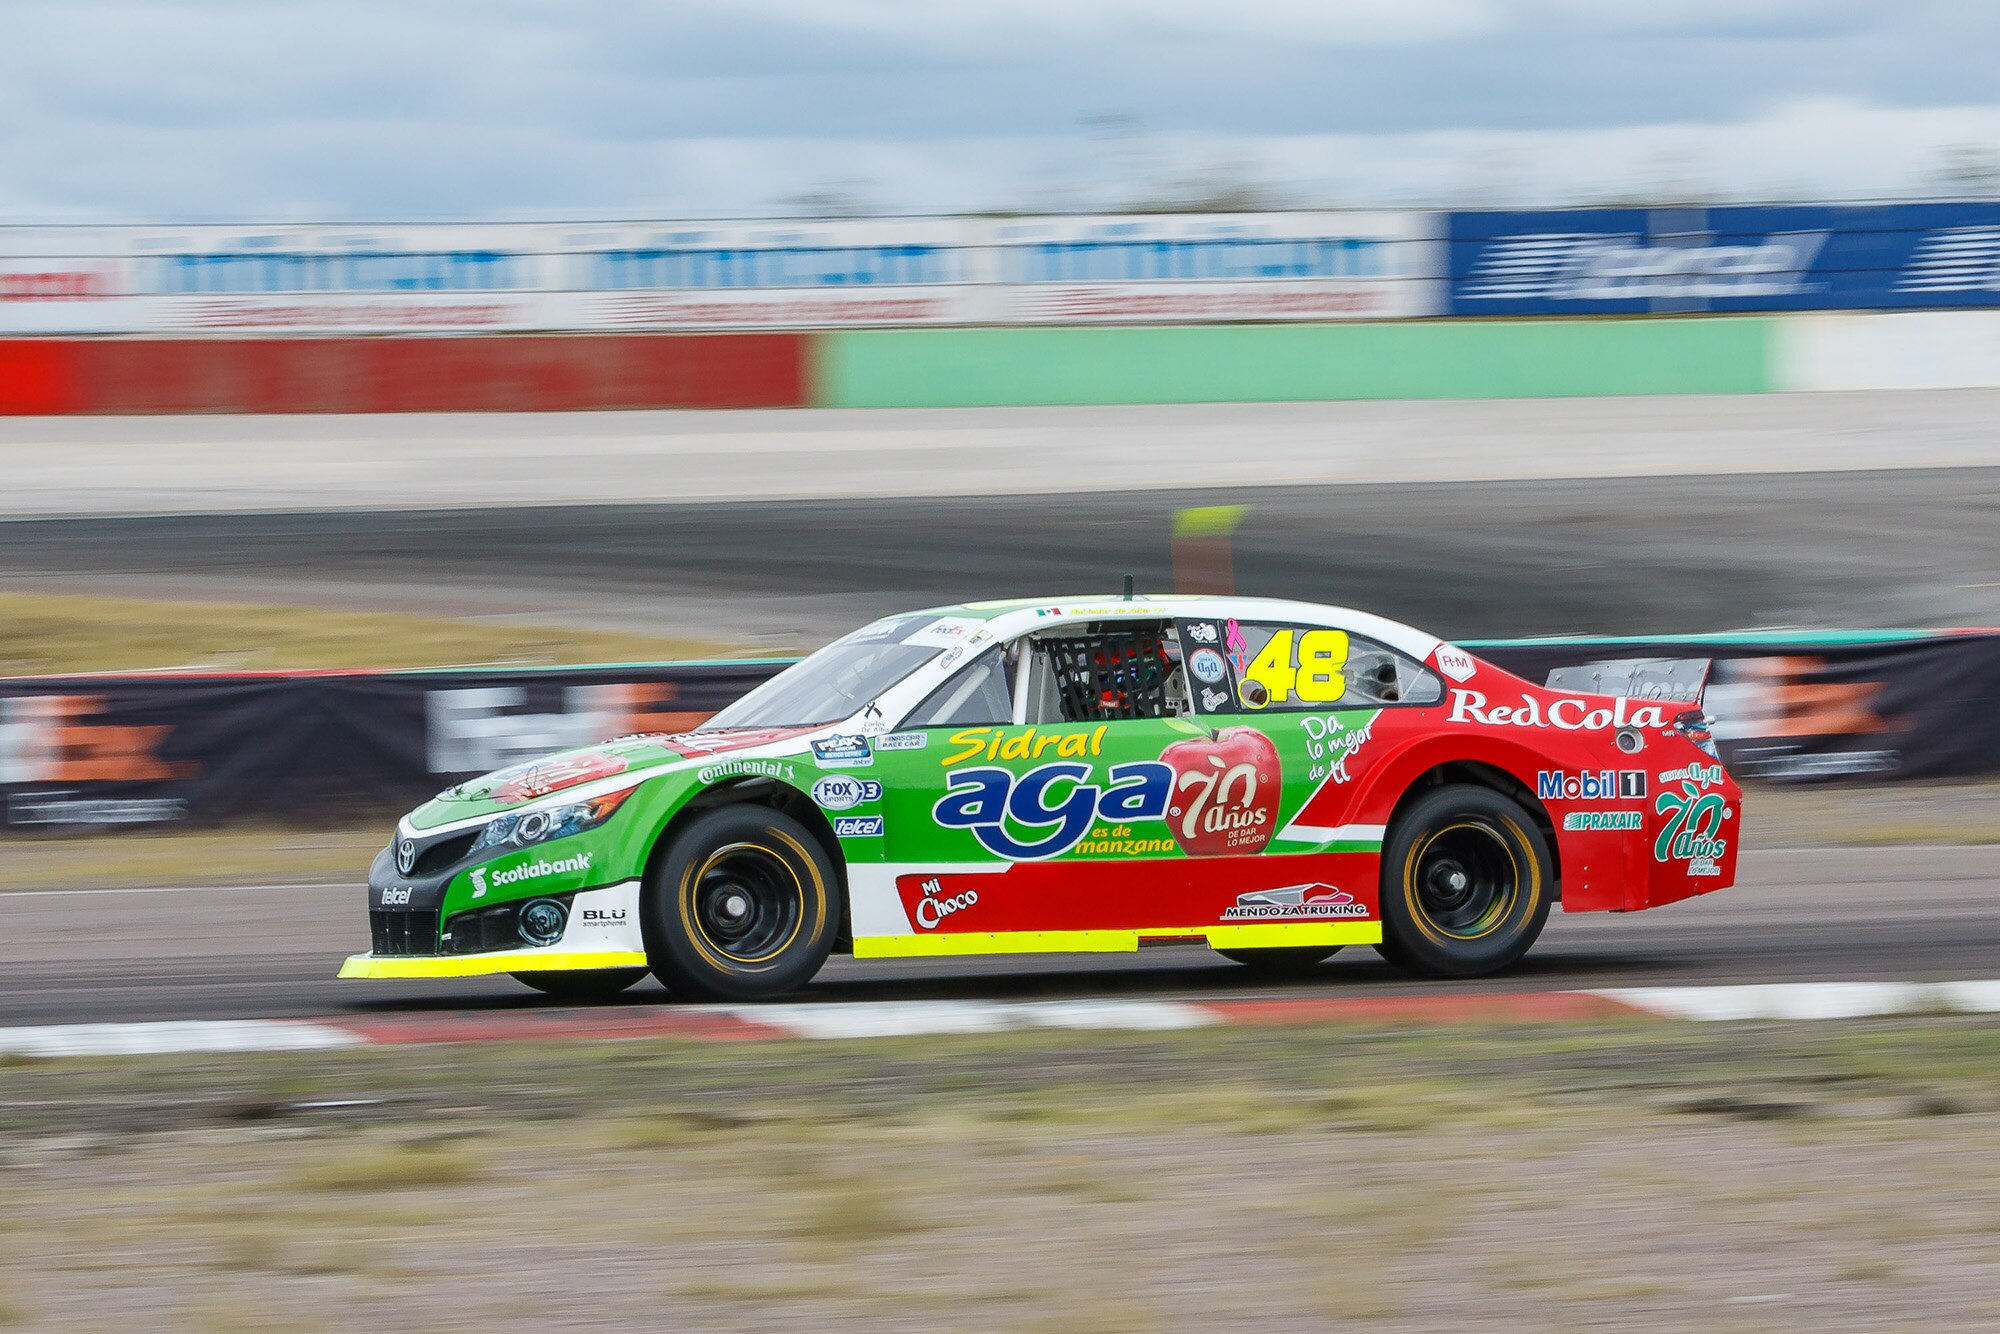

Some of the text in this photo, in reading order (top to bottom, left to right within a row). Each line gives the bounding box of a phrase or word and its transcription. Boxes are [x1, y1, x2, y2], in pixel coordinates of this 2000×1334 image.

[1245, 629, 1350, 702] 48
[1299, 715, 1344, 740] Da
[941, 725, 1108, 767] Sidral
[1305, 726, 1372, 760] lo mejor
[697, 761, 782, 785] Continental
[1309, 763, 1325, 781] de
[1659, 769, 1689, 783] SIDRAL
[823, 783, 852, 796] FOX
[865, 783, 878, 798] 3
[1538, 770, 1616, 799] Mobil
[932, 761, 1177, 861] aga
[1178, 762, 1257, 839] 70
[836, 819, 881, 835] telcel
[1204, 805, 1267, 833] años
[1581, 813, 1642, 829] PRAXAIR
[1655, 792, 1725, 862] 70
[1091, 824, 1131, 838] es de
[1227, 834, 1266, 847] LO MEJOR
[1228, 827, 1257, 839] DE DAR
[1074, 838, 1175, 856] manzana
[1673, 831, 1726, 859] años
[491, 852, 592, 887] Scotiabank
[381, 886, 413, 905] telcel
[921, 878, 942, 896] Mi
[916, 890, 978, 929] Choco
[1227, 905, 1366, 917] MENDOZA TRUKING
